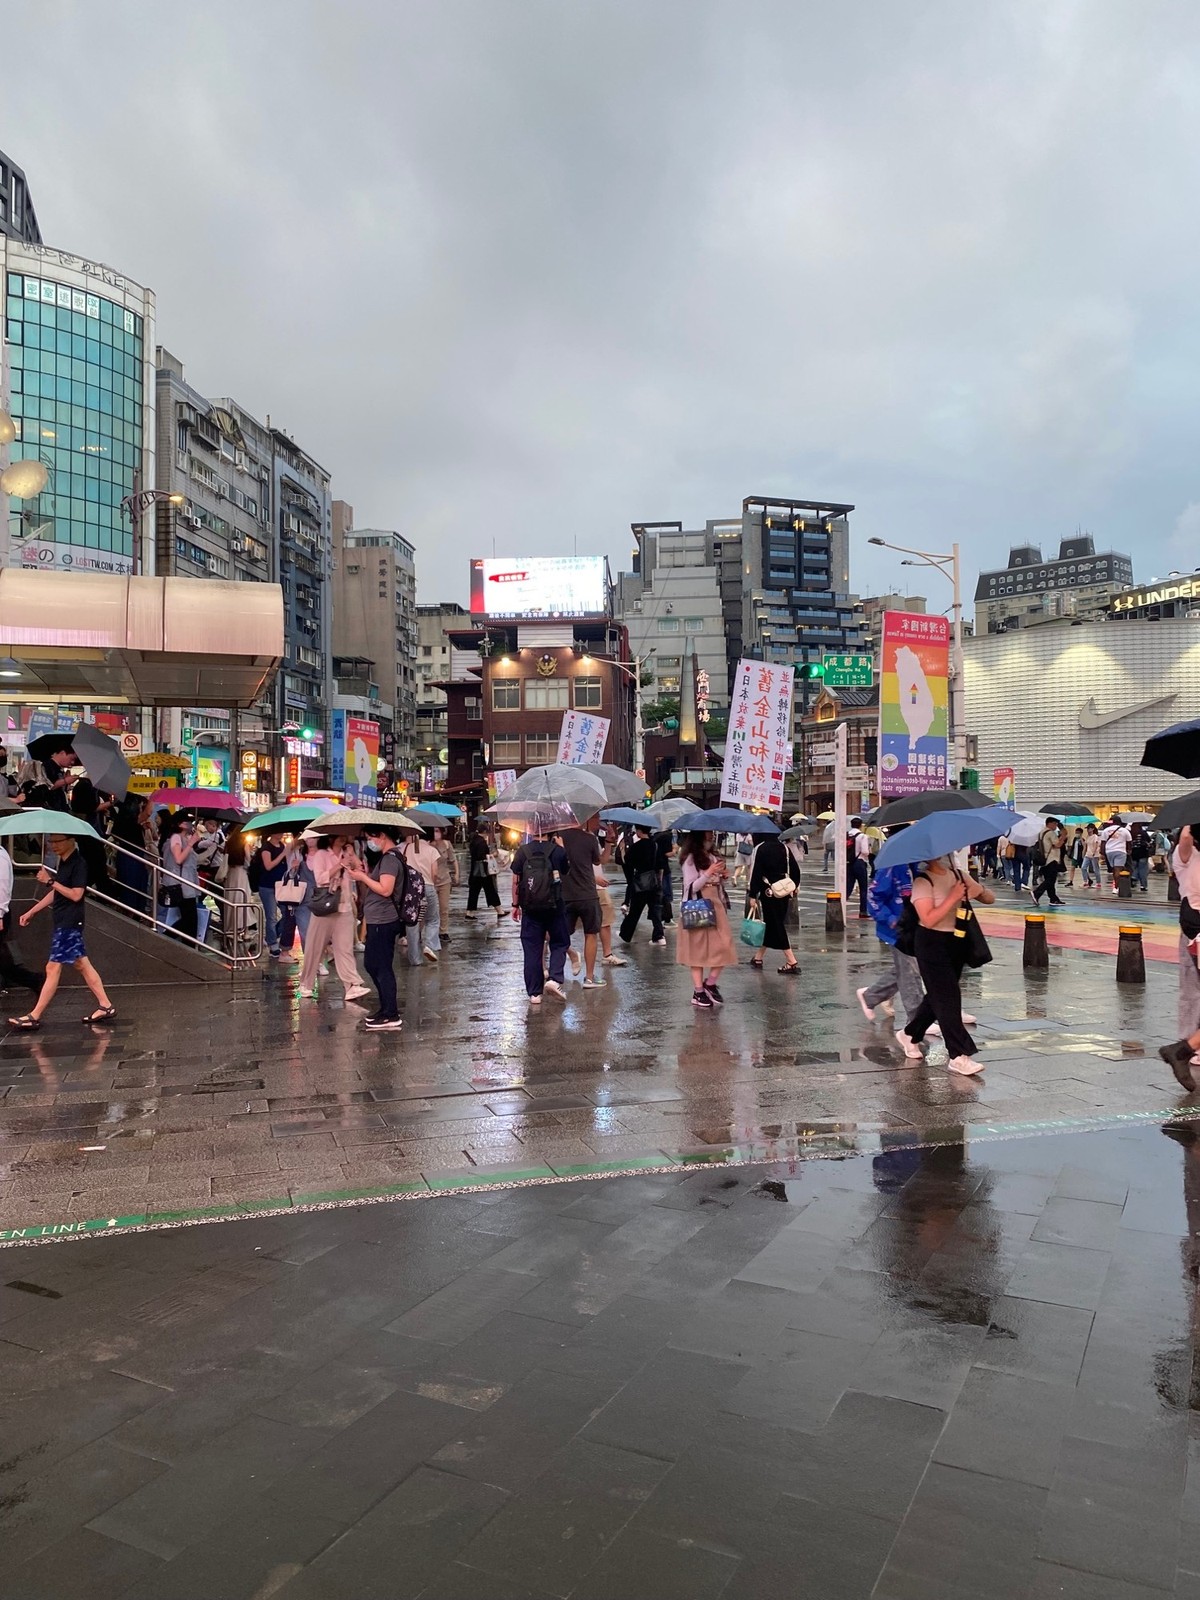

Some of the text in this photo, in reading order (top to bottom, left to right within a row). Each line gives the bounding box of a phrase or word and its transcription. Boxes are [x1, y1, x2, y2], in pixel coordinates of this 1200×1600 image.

[75, 556, 114, 572] LOSTTW.COM
[829, 657, 867, 667] 成都路
[41, 1221, 87, 1235] LINE
